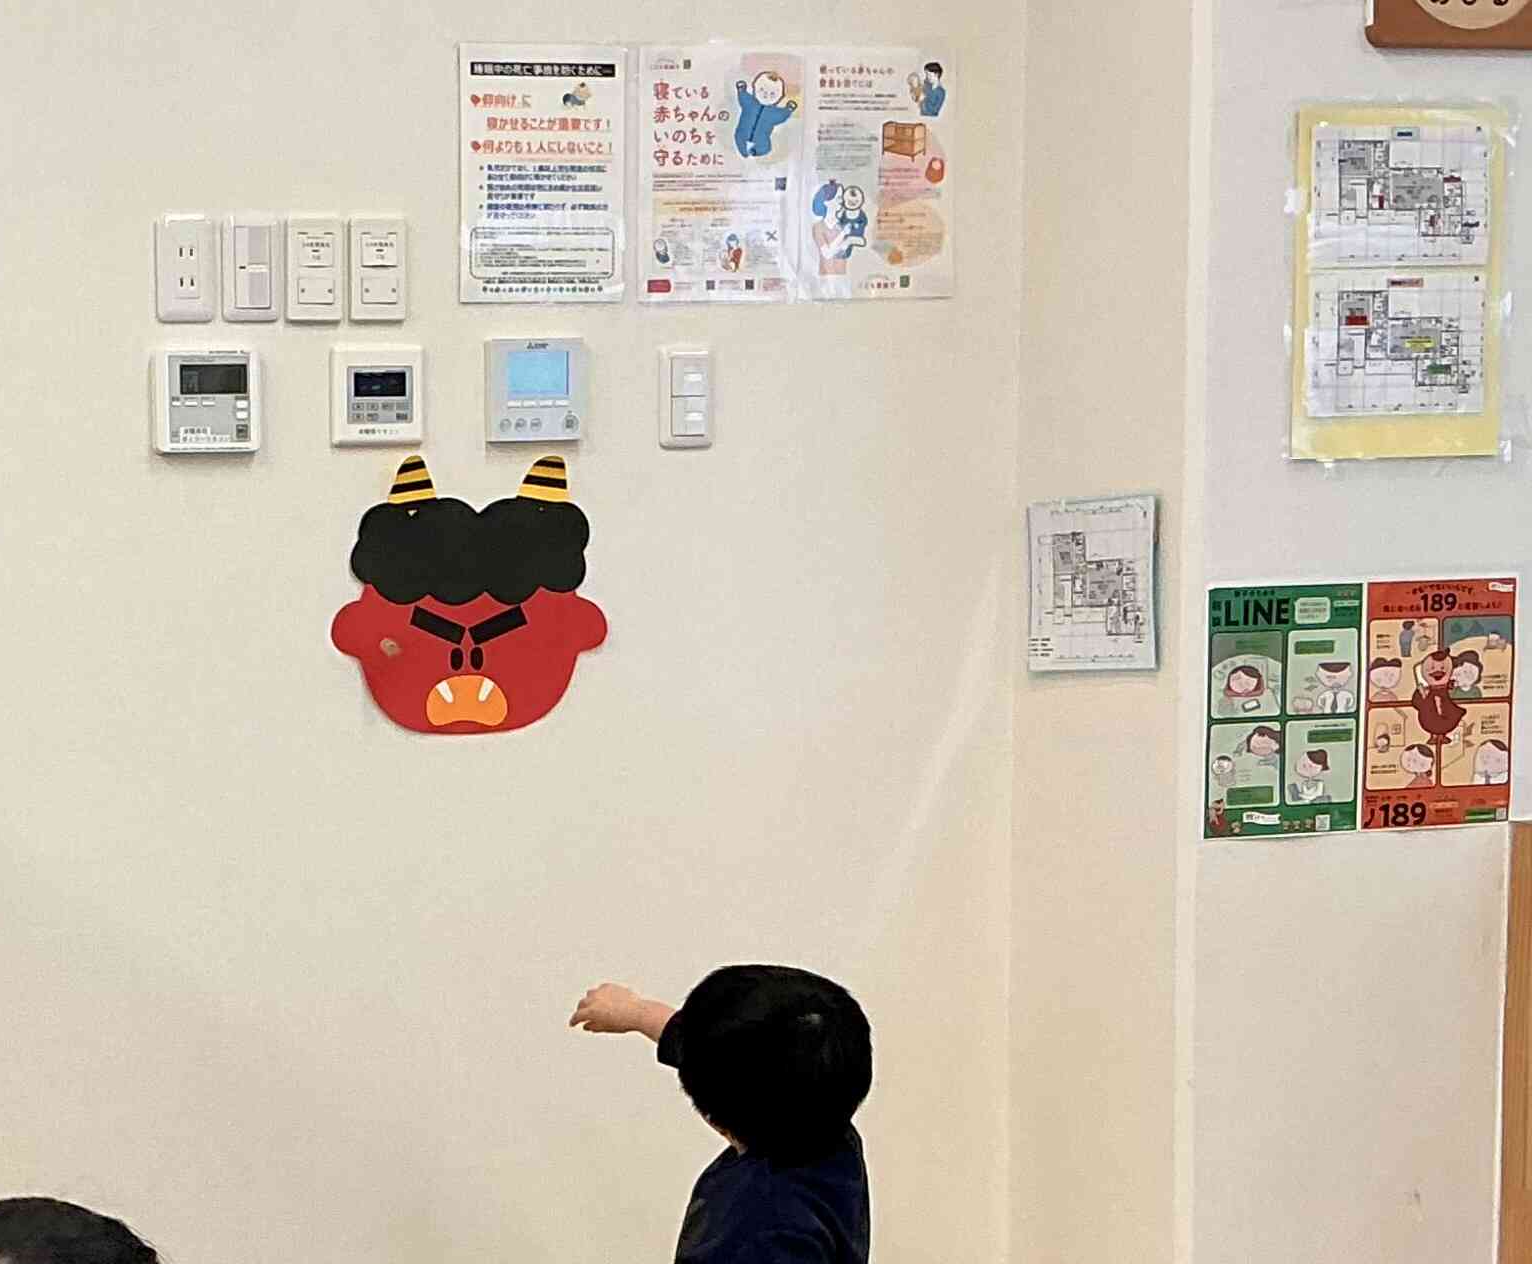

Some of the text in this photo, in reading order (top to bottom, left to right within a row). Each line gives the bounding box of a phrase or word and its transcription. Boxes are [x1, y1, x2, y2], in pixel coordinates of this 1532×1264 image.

[653, 81, 710, 100] 寝ている
[653, 106, 730, 123] 赤ちゃんの
[653, 128, 716, 144] いのちを
[653, 148, 725, 166] 守るために
[1224, 597, 1290, 626] LINE
[1420, 593, 1458, 612] 189
[1379, 802, 1427, 827] 189
